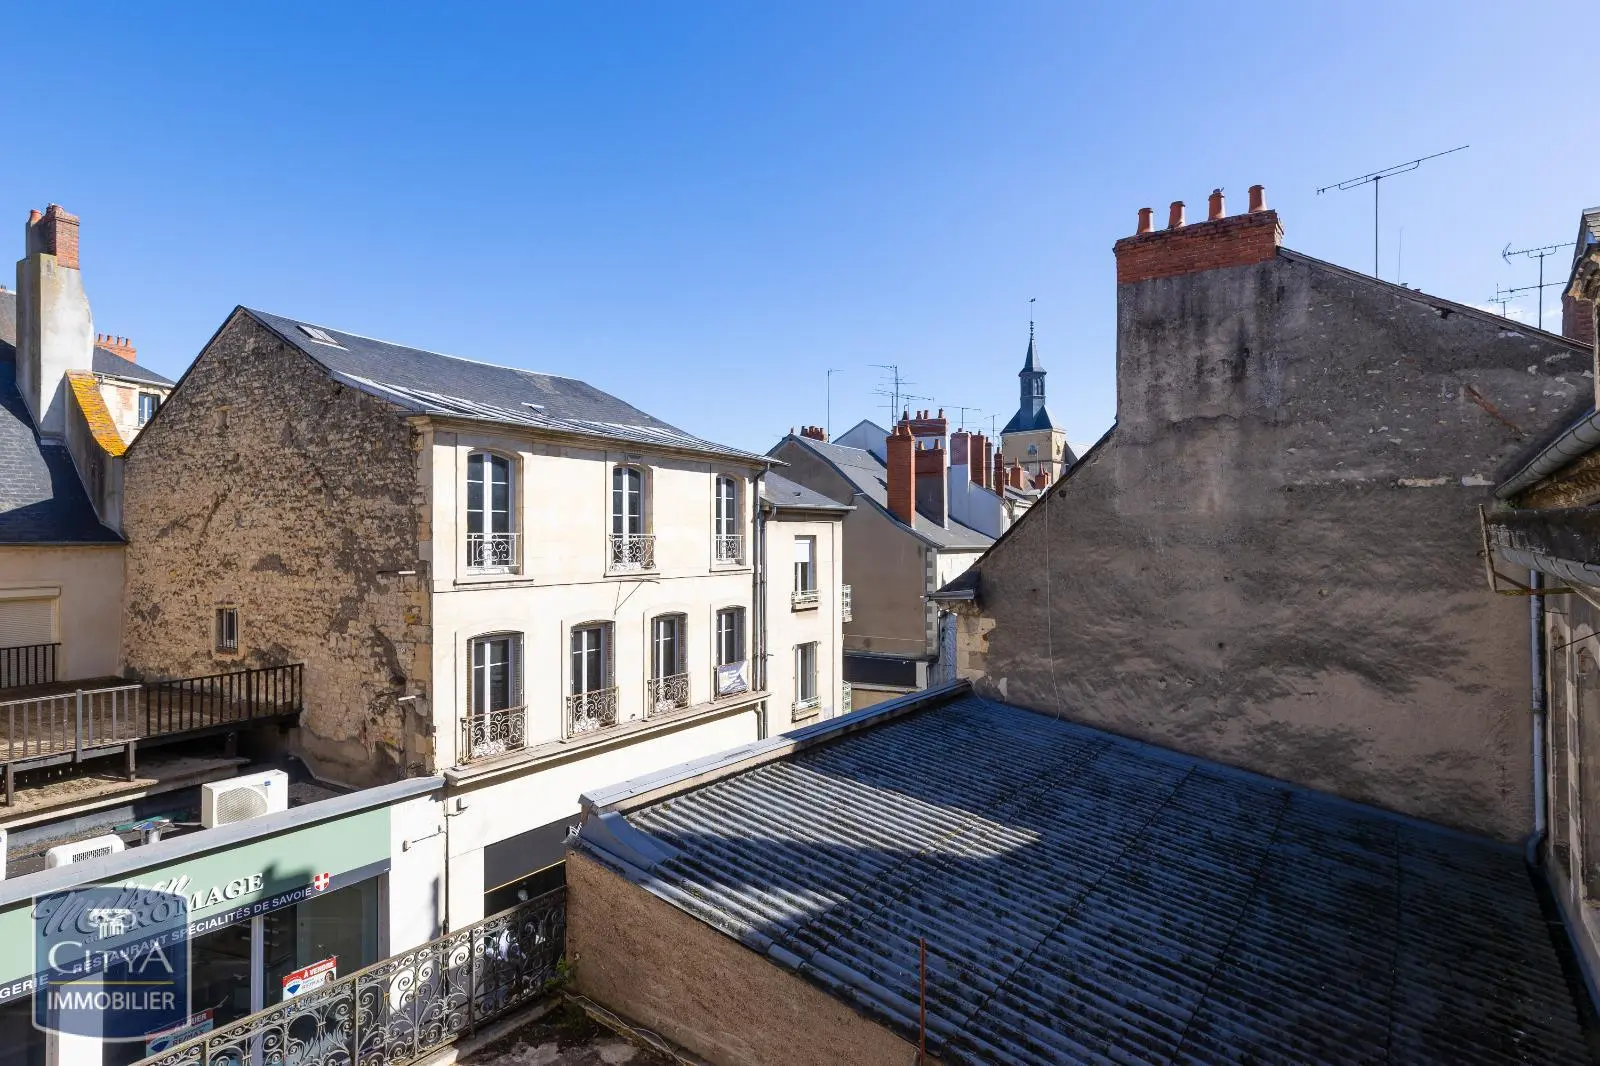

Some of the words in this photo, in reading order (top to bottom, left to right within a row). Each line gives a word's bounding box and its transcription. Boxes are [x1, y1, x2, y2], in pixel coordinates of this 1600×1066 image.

[0, 974, 49, 999] GERIE
[73, 934, 168, 974] RESTAURANT
[171, 907, 251, 941] SPÉCIALITÉS
[254, 901, 270, 914] DE
[272, 887, 312, 907] SAVOIE
[101, 872, 264, 939] ROMAGE
